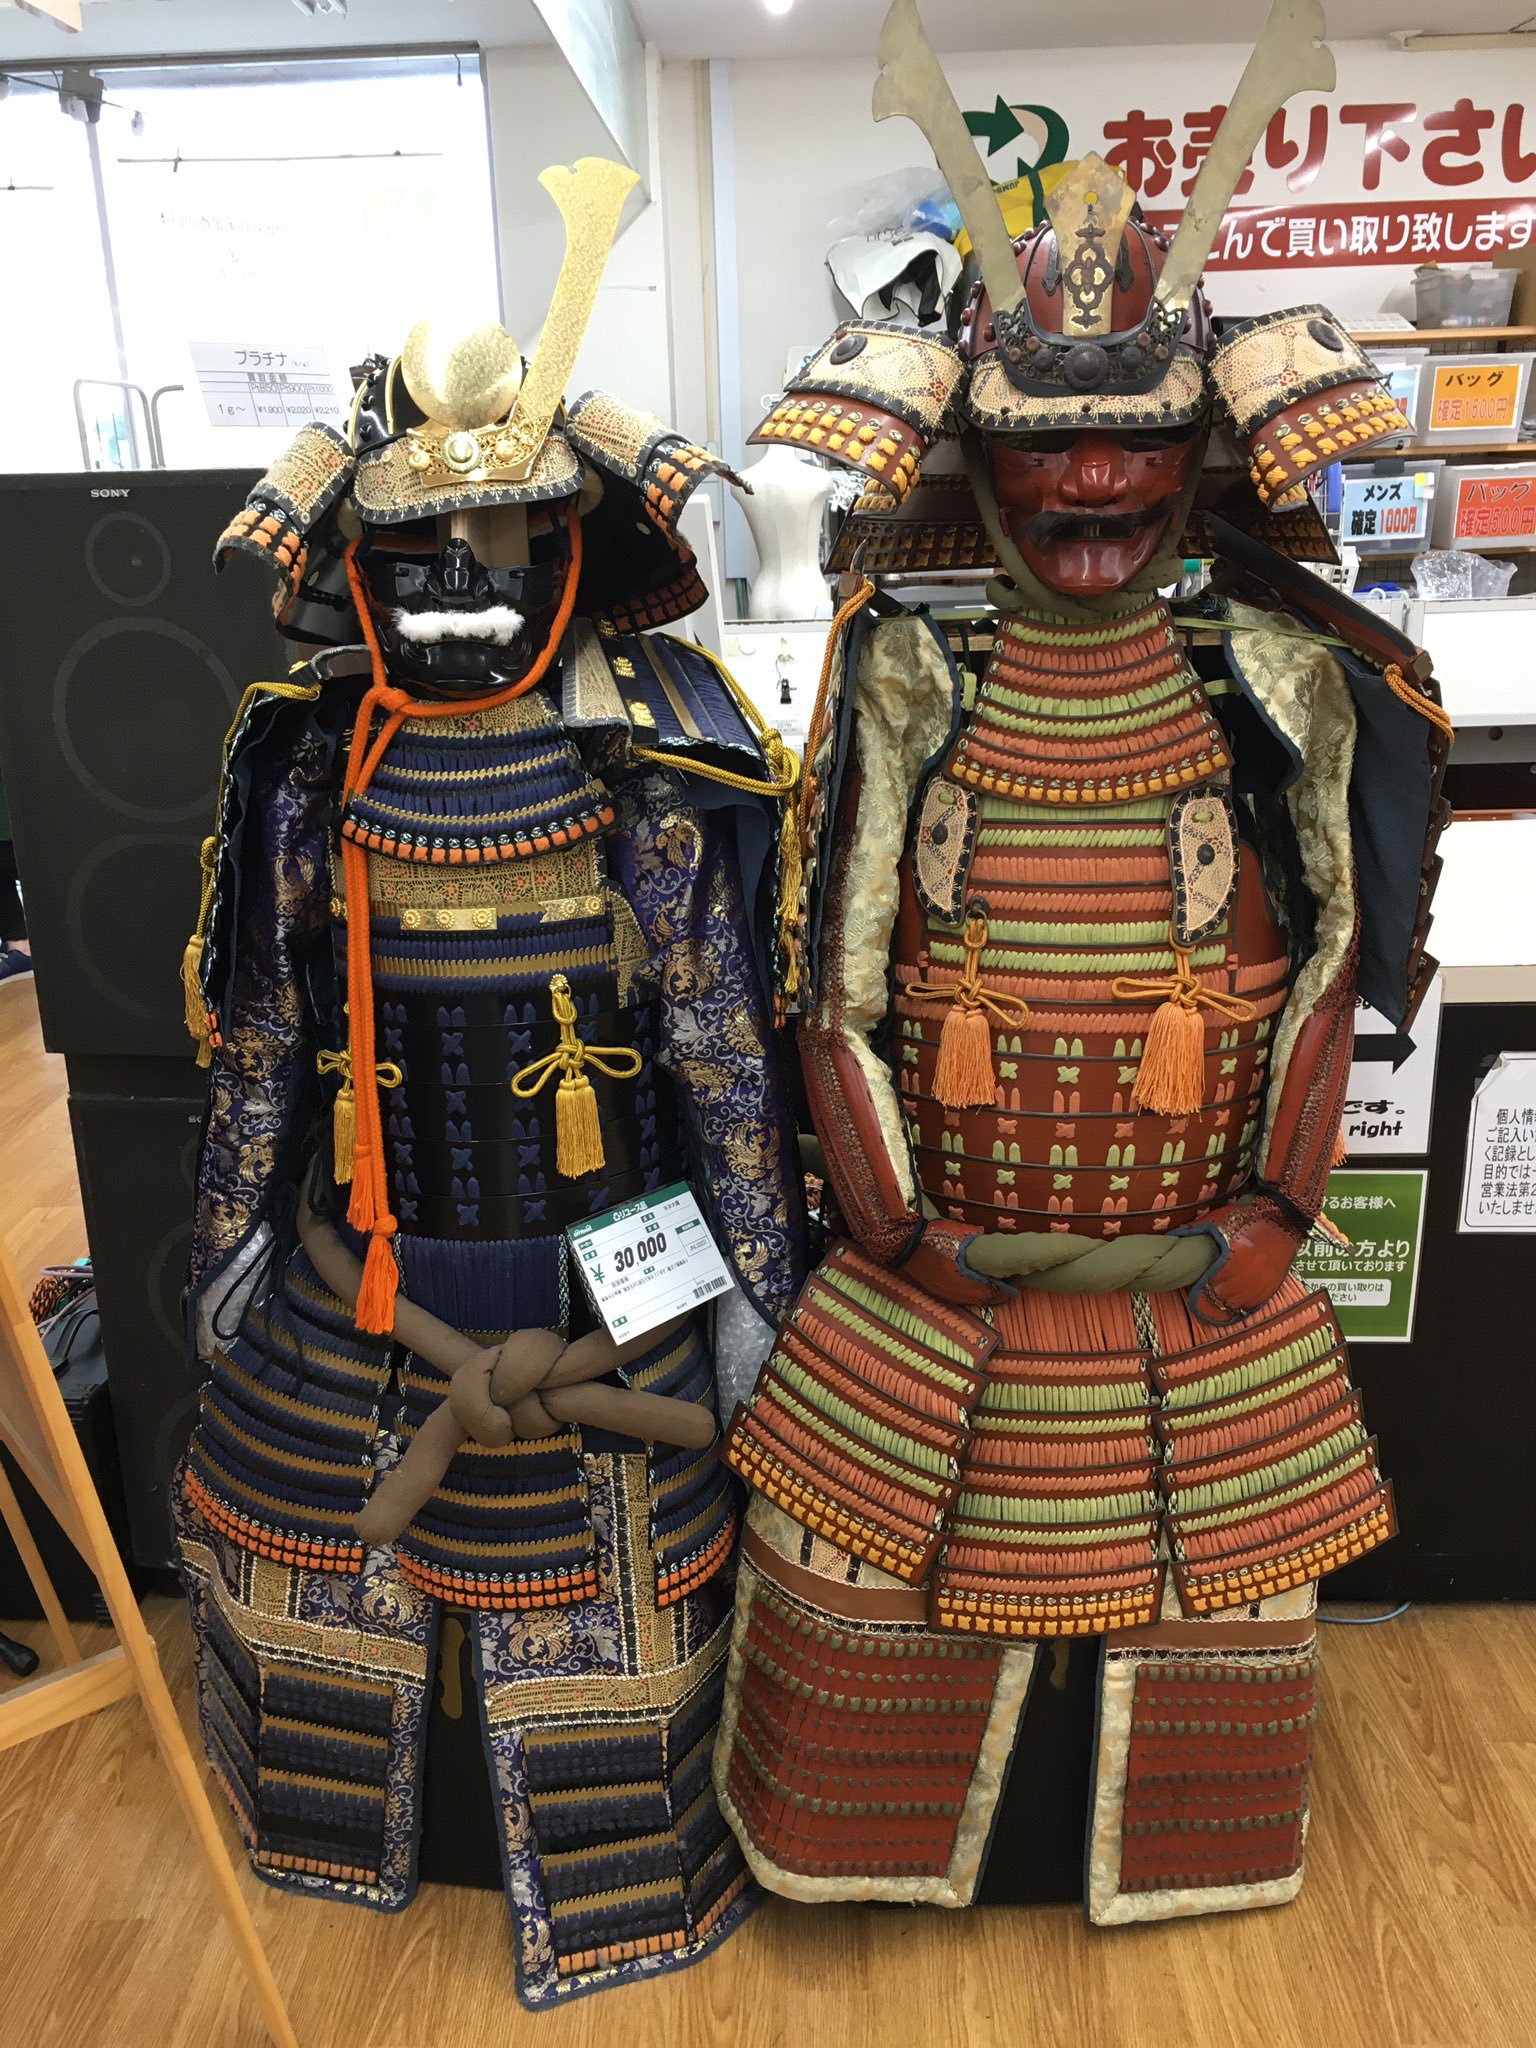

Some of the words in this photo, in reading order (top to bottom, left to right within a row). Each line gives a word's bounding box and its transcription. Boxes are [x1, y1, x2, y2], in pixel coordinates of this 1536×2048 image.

[1163, 211, 1536, 260] んで買い取り致します
[234, 349, 288, 367] プラチナ
[1445, 370, 1504, 388] バッグ
[90, 488, 131, 498] SONY
[1363, 482, 1403, 502] メンズ
[1467, 481, 1533, 502] バッグ
[1496, 1108, 1536, 1126] 個人情
[1349, 1120, 1404, 1139] right
[1486, 1126, 1536, 1144] ご記入い
[1478, 1201, 1536, 1216] いたしませ
[589, 1263, 606, 1285] ¥
[613, 1232, 668, 1273] 30,000
